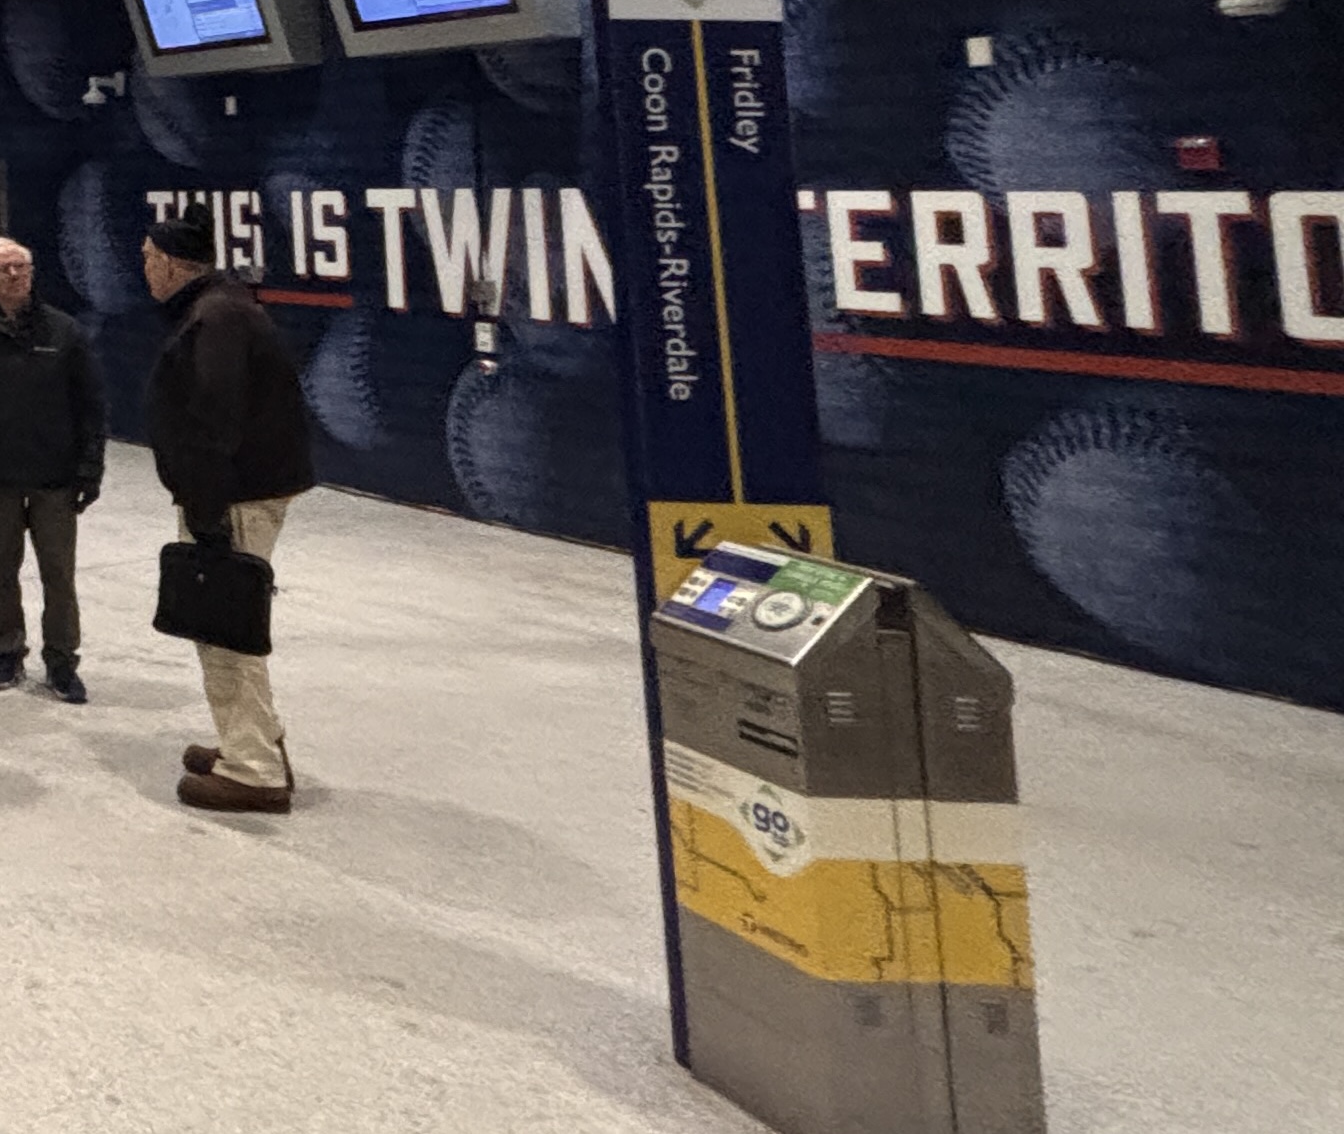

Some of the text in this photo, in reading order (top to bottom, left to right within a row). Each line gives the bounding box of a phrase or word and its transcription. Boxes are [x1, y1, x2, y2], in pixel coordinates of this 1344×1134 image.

[728, 49, 765, 154] Fridley
[290, 190, 349, 277] IS
[797, 189, 1344, 341] ERRITO
[641, 47, 700, 401] Coon Rapids-Riverdale
[752, 802, 790, 833] go
